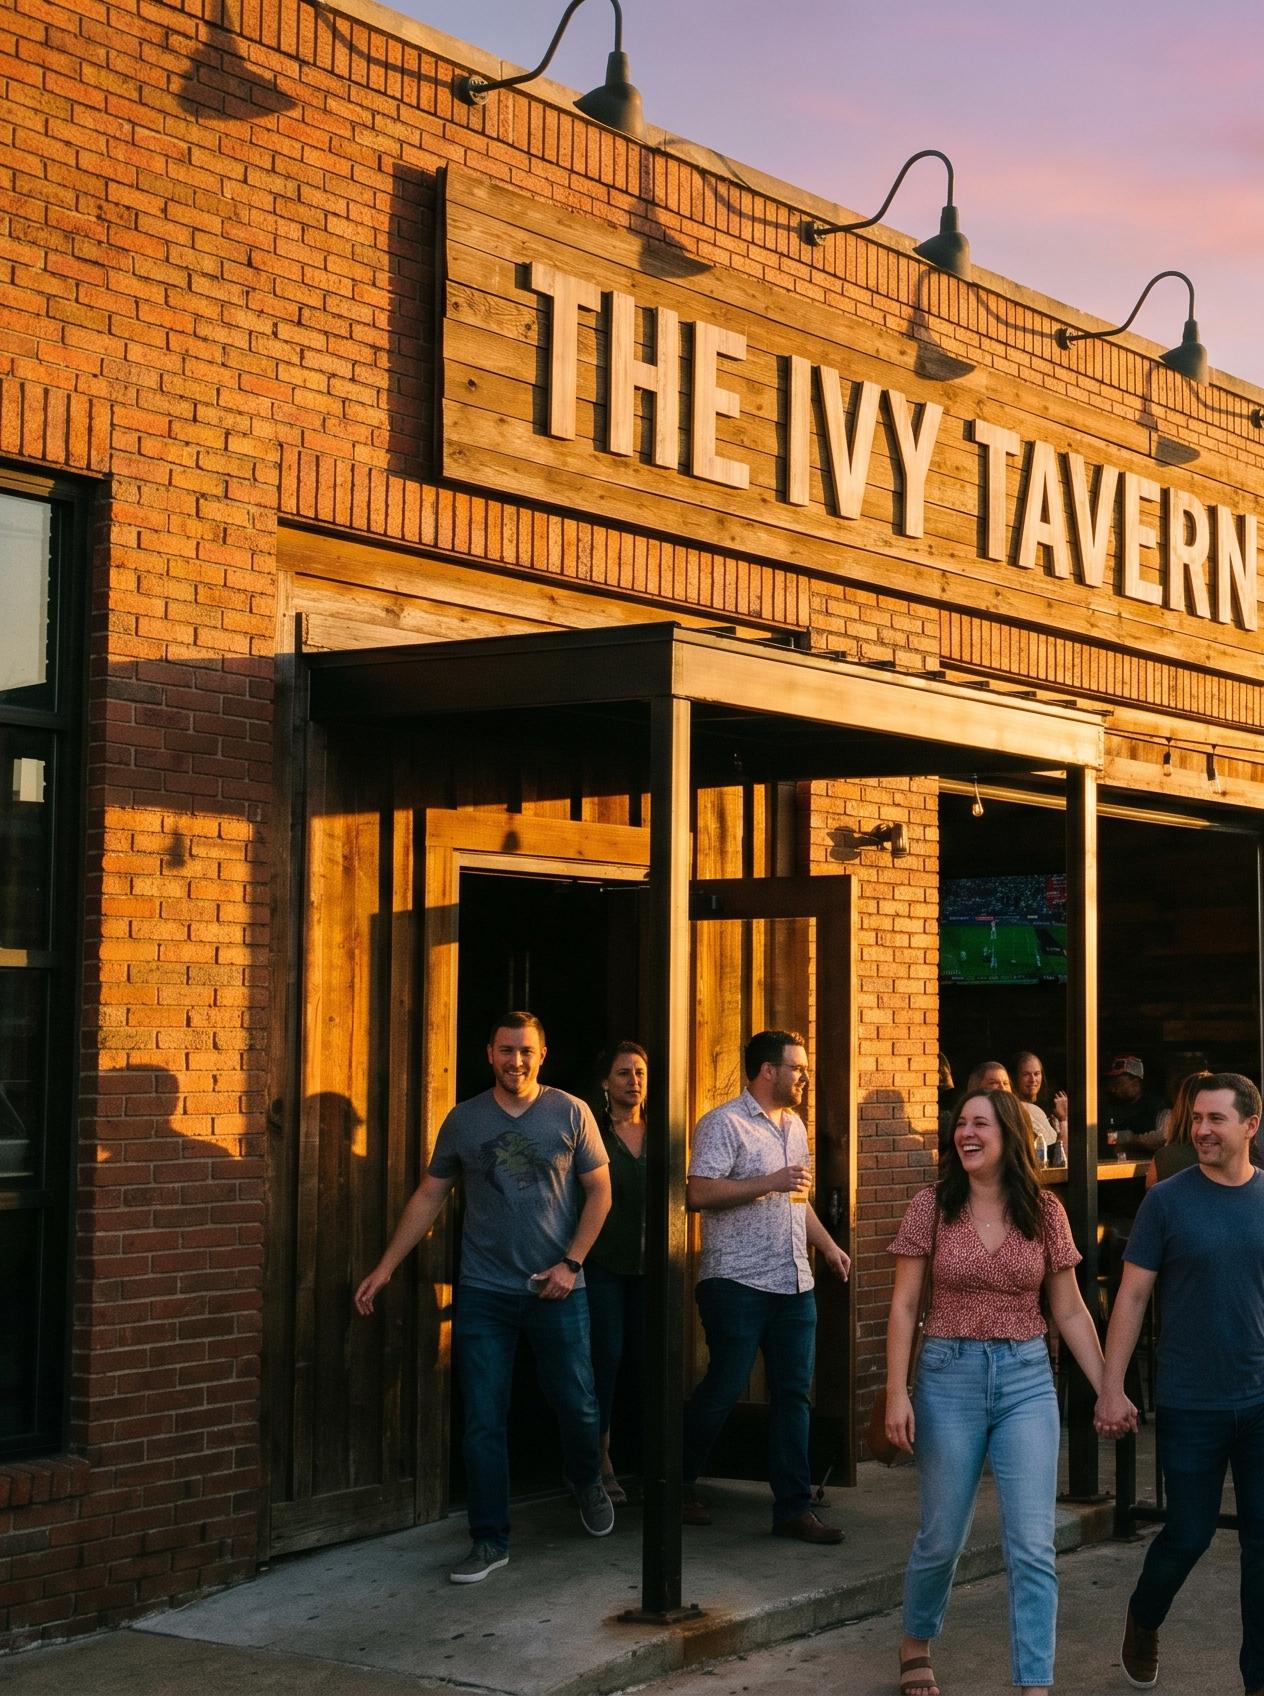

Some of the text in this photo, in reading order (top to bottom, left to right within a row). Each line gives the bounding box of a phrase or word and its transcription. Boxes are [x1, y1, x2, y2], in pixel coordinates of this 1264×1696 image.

[527, 261, 1258, 632] THE IVY TAVERN
